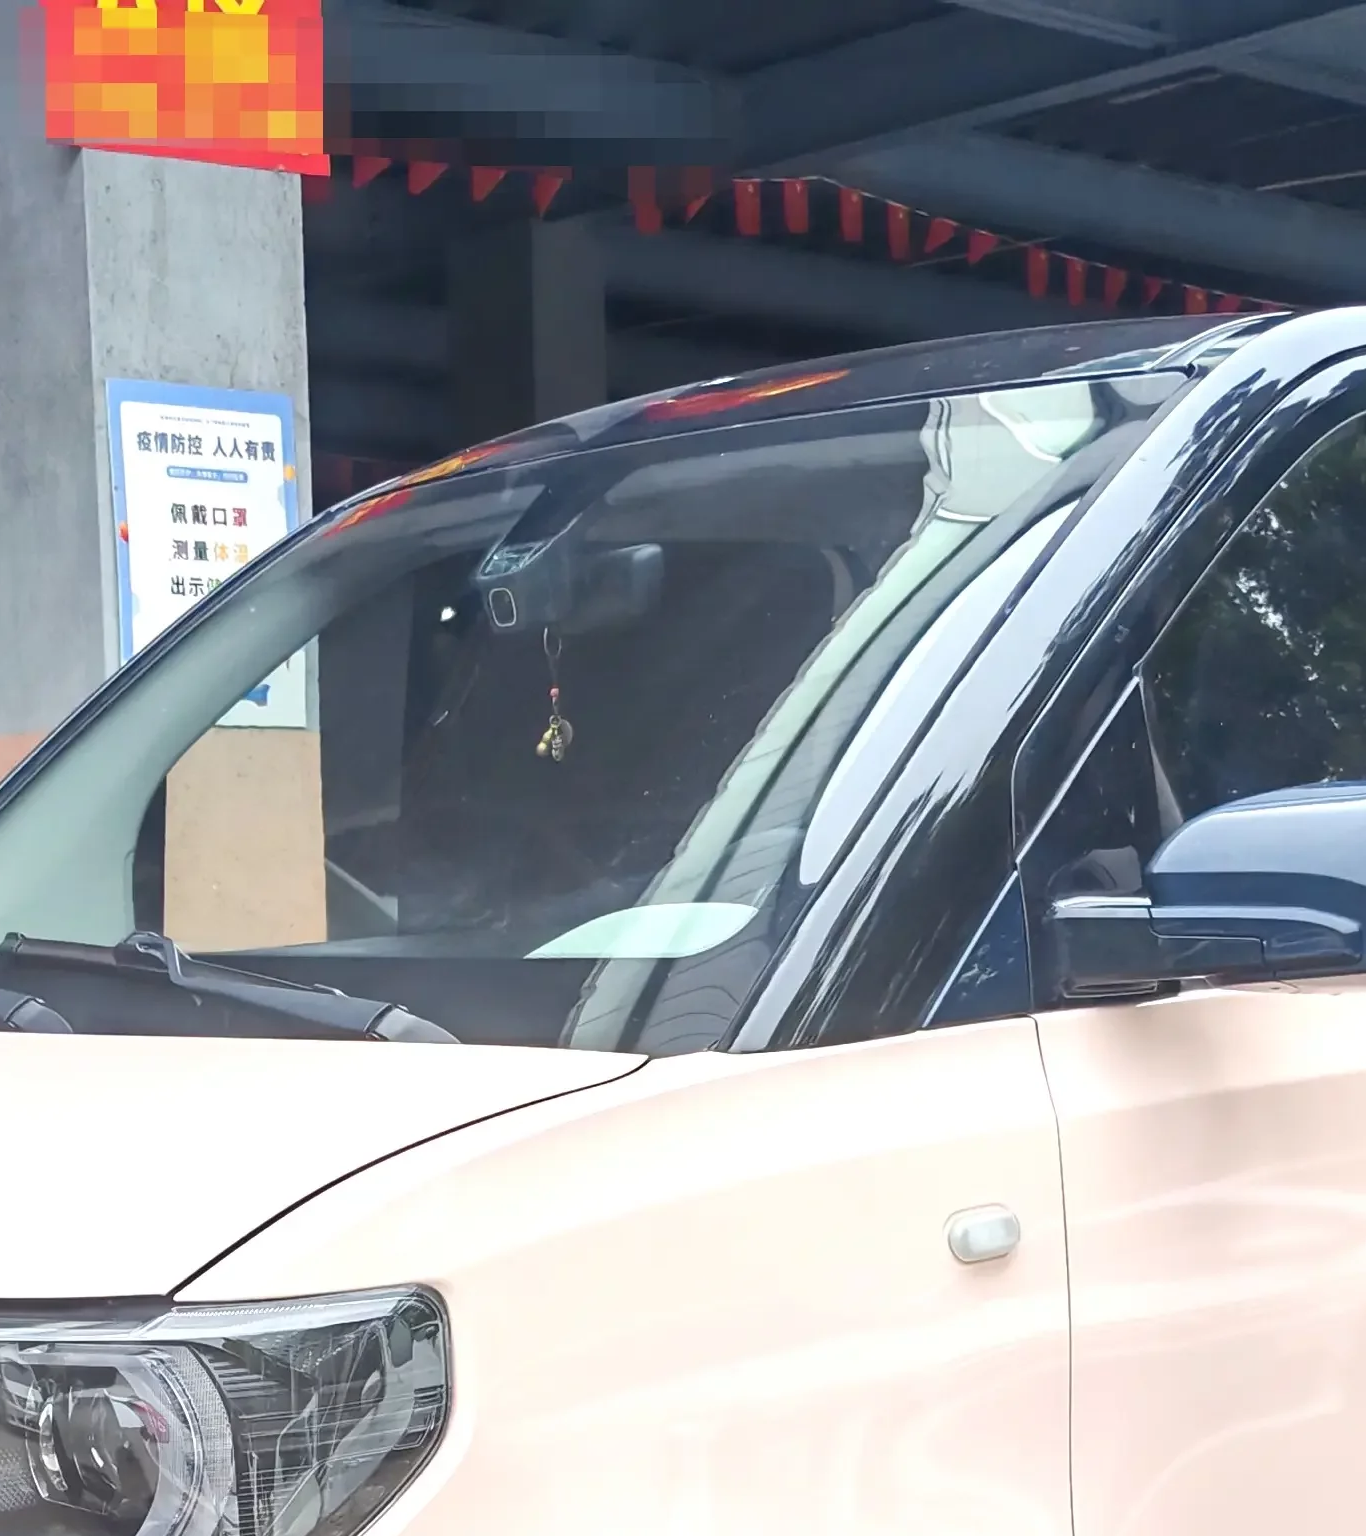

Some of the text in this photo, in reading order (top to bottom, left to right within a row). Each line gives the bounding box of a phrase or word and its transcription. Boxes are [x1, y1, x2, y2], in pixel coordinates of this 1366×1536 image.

[136, 430, 276, 462] 疫情防控 人人有责
